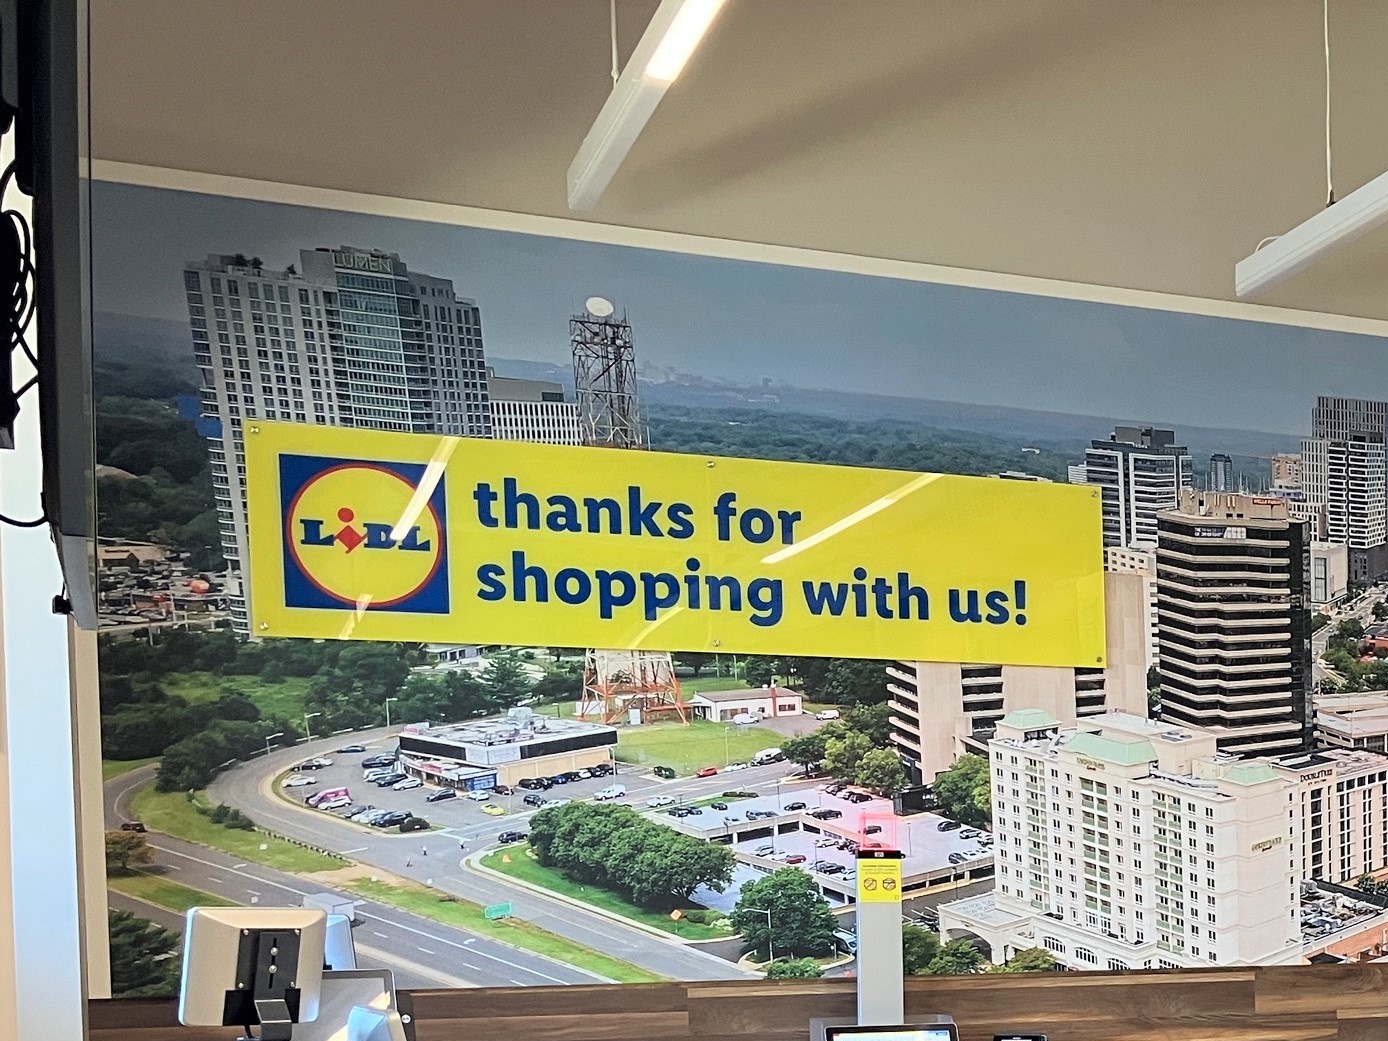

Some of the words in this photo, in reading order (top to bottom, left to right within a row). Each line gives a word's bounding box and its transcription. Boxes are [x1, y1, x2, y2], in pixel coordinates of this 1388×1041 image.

[332, 251, 392, 273] LUMEN
[473, 477, 695, 539] thanks
[713, 492, 803, 546] for
[477, 550, 784, 628] shopping
[803, 567, 930, 621] with
[948, 580, 1028, 626] us!
